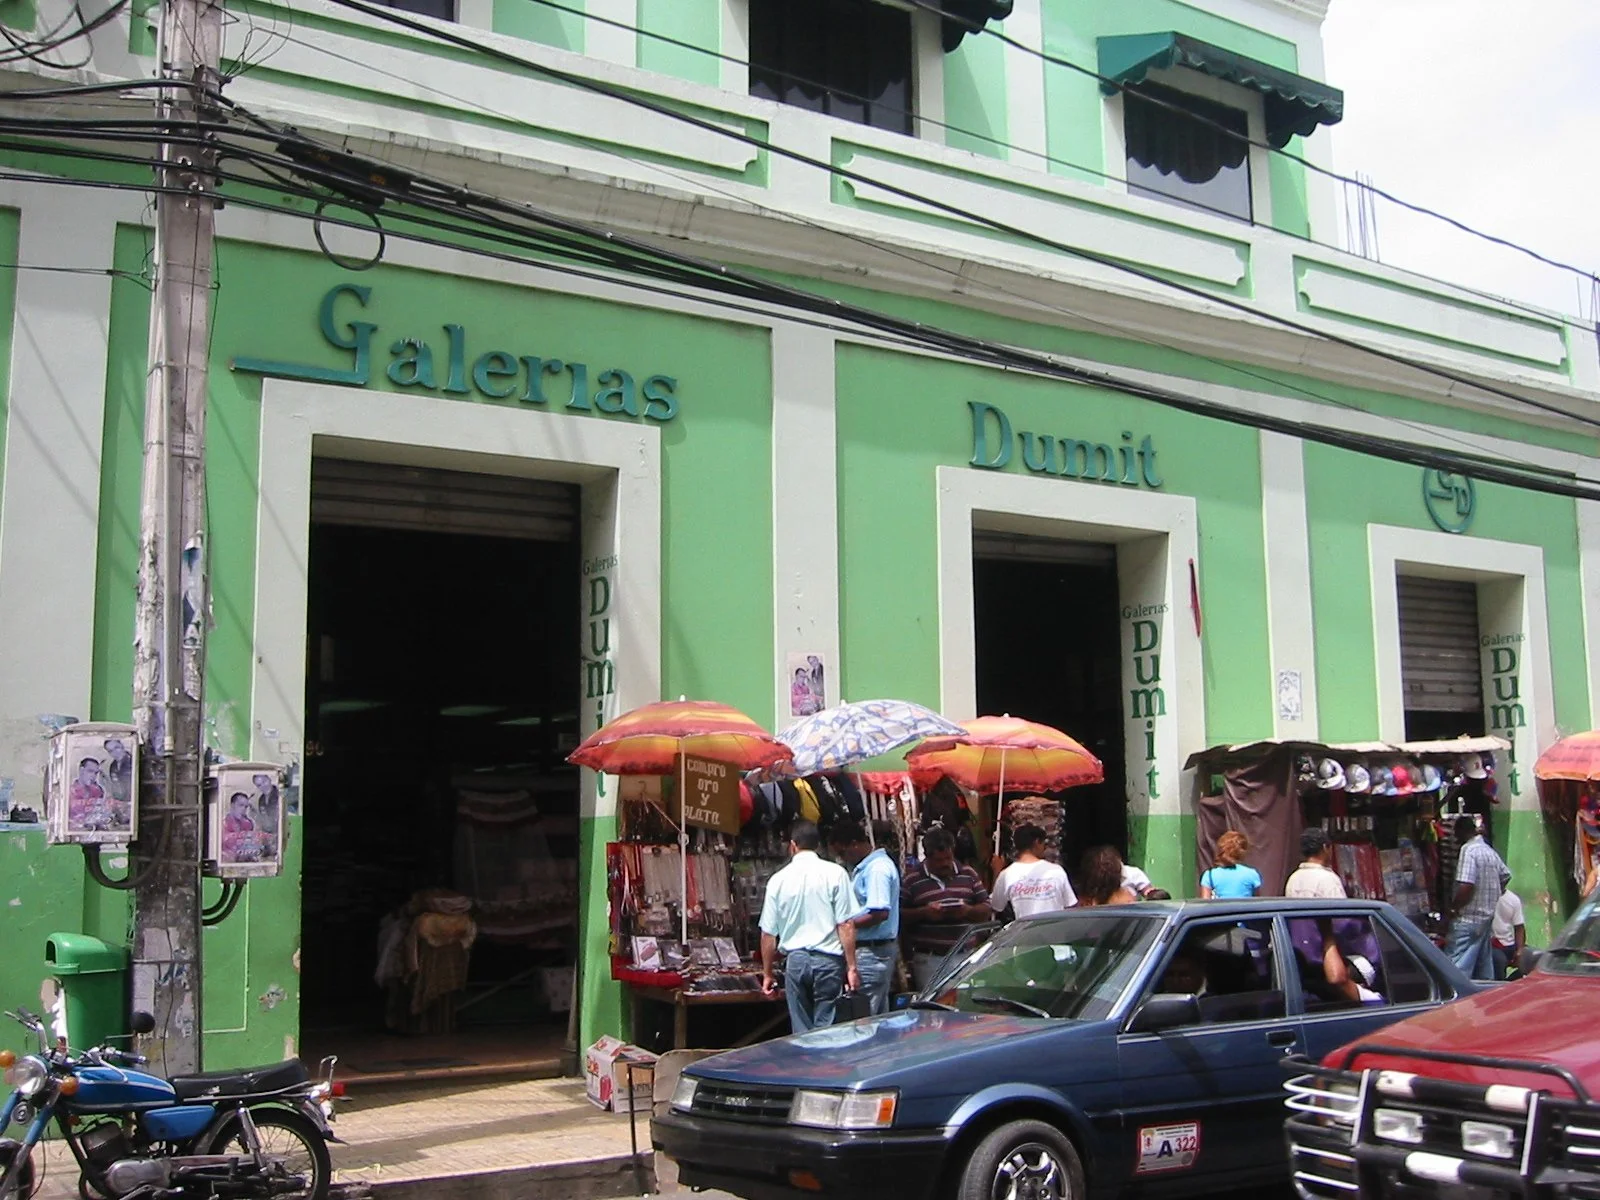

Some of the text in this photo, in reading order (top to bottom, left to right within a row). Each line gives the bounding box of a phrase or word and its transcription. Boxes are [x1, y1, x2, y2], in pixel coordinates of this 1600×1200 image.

[230, 284, 679, 421] Galerias
[967, 401, 1165, 488] Dumit
[1122, 602, 1170, 620] Galerias
[1481, 632, 1526, 647] Galerias
[1130, 619, 1168, 800] Dumit
[1490, 647, 1527, 797] Dumit
[1157, 1135, 1197, 1159] A 322
